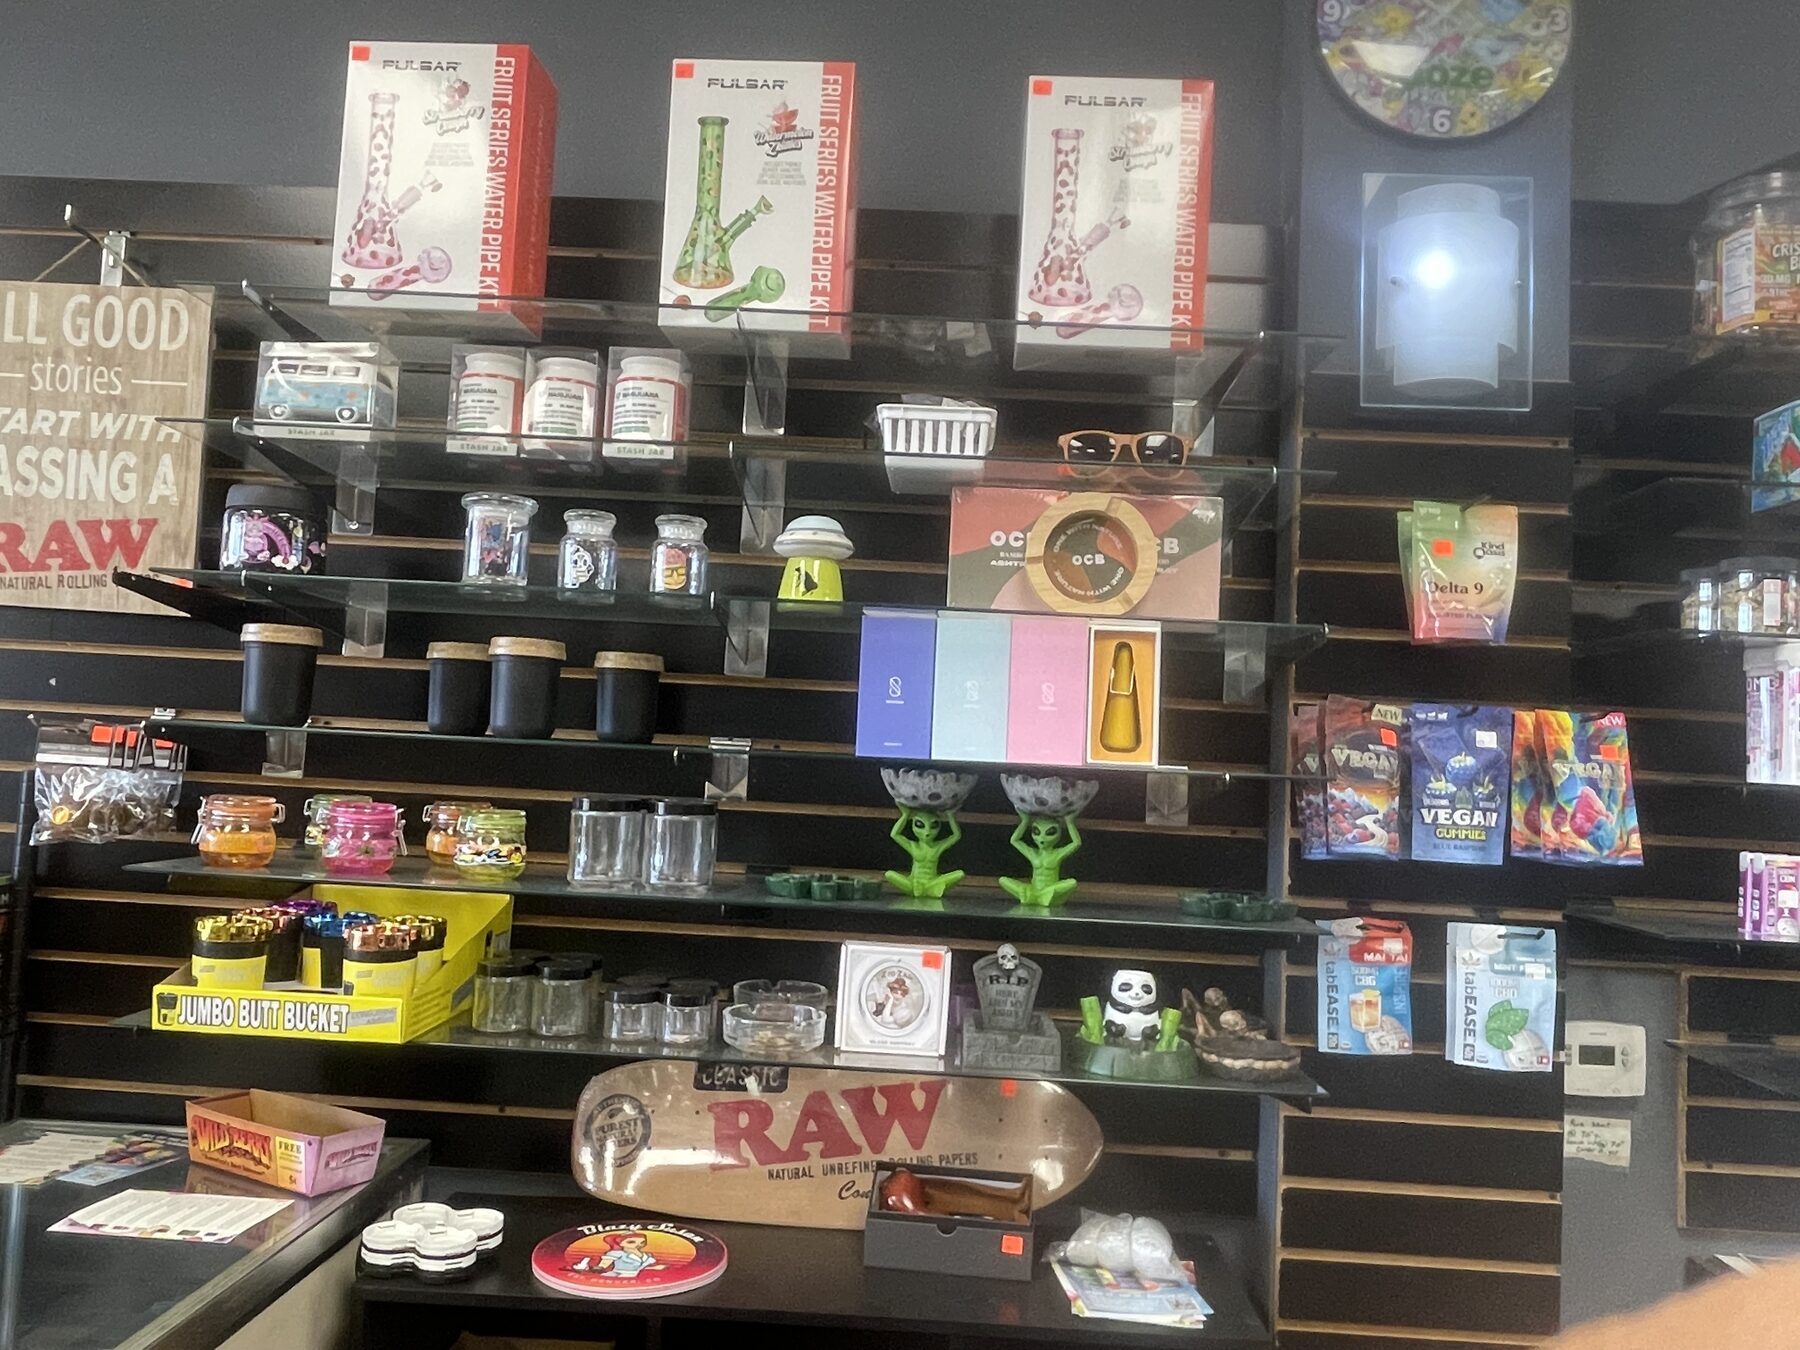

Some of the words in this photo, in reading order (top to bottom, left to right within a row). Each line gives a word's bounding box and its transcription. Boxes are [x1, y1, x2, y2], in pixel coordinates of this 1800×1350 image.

[1322, 0, 1342, 23] 9
[382, 59, 460, 72] PULSAR
[492, 57, 516, 108] FRUIT
[707, 77, 786, 91] PULSAR
[820, 75, 843, 123] FRUIT
[1064, 95, 1146, 108] PULSAR
[1180, 92, 1203, 144] FRUIT
[1432, 108, 1450, 133] 6
[488, 107, 513, 168] SERIES
[816, 127, 840, 187] SERIES
[1176, 144, 1200, 205] SERIES
[483, 171, 508, 230] WATER
[812, 190, 836, 249] WATER
[480, 233, 503, 273] PIPE
[1173, 209, 1197, 267] WATER
[810, 253, 833, 292] PIPE
[478, 278, 500, 309] KIT
[1171, 272, 1194, 310] PIPE
[62, 294, 189, 352] GOOD
[808, 296, 831, 328] KIT
[1170, 314, 1193, 345] KIT
[29, 356, 123, 396] stories
[460, 443, 489, 451] STASH
[616, 446, 645, 455] STASH
[148, 452, 180, 506] A
[0, 517, 159, 573] RAW
[990, 530, 1031, 548] OC
[1072, 553, 1105, 566] OCB
[0, 574, 51, 590] NATURAL
[57, 573, 108, 589] ROLLING
[1428, 581, 1469, 594] Delta
[1473, 582, 1484, 595] 9
[1376, 708, 1400, 721] NEW
[1601, 715, 1623, 727] NEW
[1331, 748, 1399, 772] VEGAN
[1420, 807, 1499, 828] VEGAN
[1436, 828, 1487, 841] GUMMIES
[1363, 952, 1386, 962] MAI
[1391, 953, 1409, 963] TAI
[1325, 961, 1339, 1031] tabEASE
[1354, 975, 1377, 986] CBG
[178, 994, 236, 1028] JUMBO
[238, 997, 281, 1031] BUTT
[283, 1000, 350, 1035] BUCKET
[1463, 971, 1478, 1043] tabEASE
[702, 1065, 782, 1088] CLASSIC
[193, 1117, 230, 1152] WILD
[595, 1117, 639, 1135] PUREST
[707, 1079, 947, 1172] RAW
[277, 1140, 302, 1154] FREE
[767, 1166, 815, 1181] NATURAL
[821, 1159, 878, 1177] UNREFINE
[938, 1152, 979, 1166] PAPERS
[577, 1223, 643, 1236] Blazy
